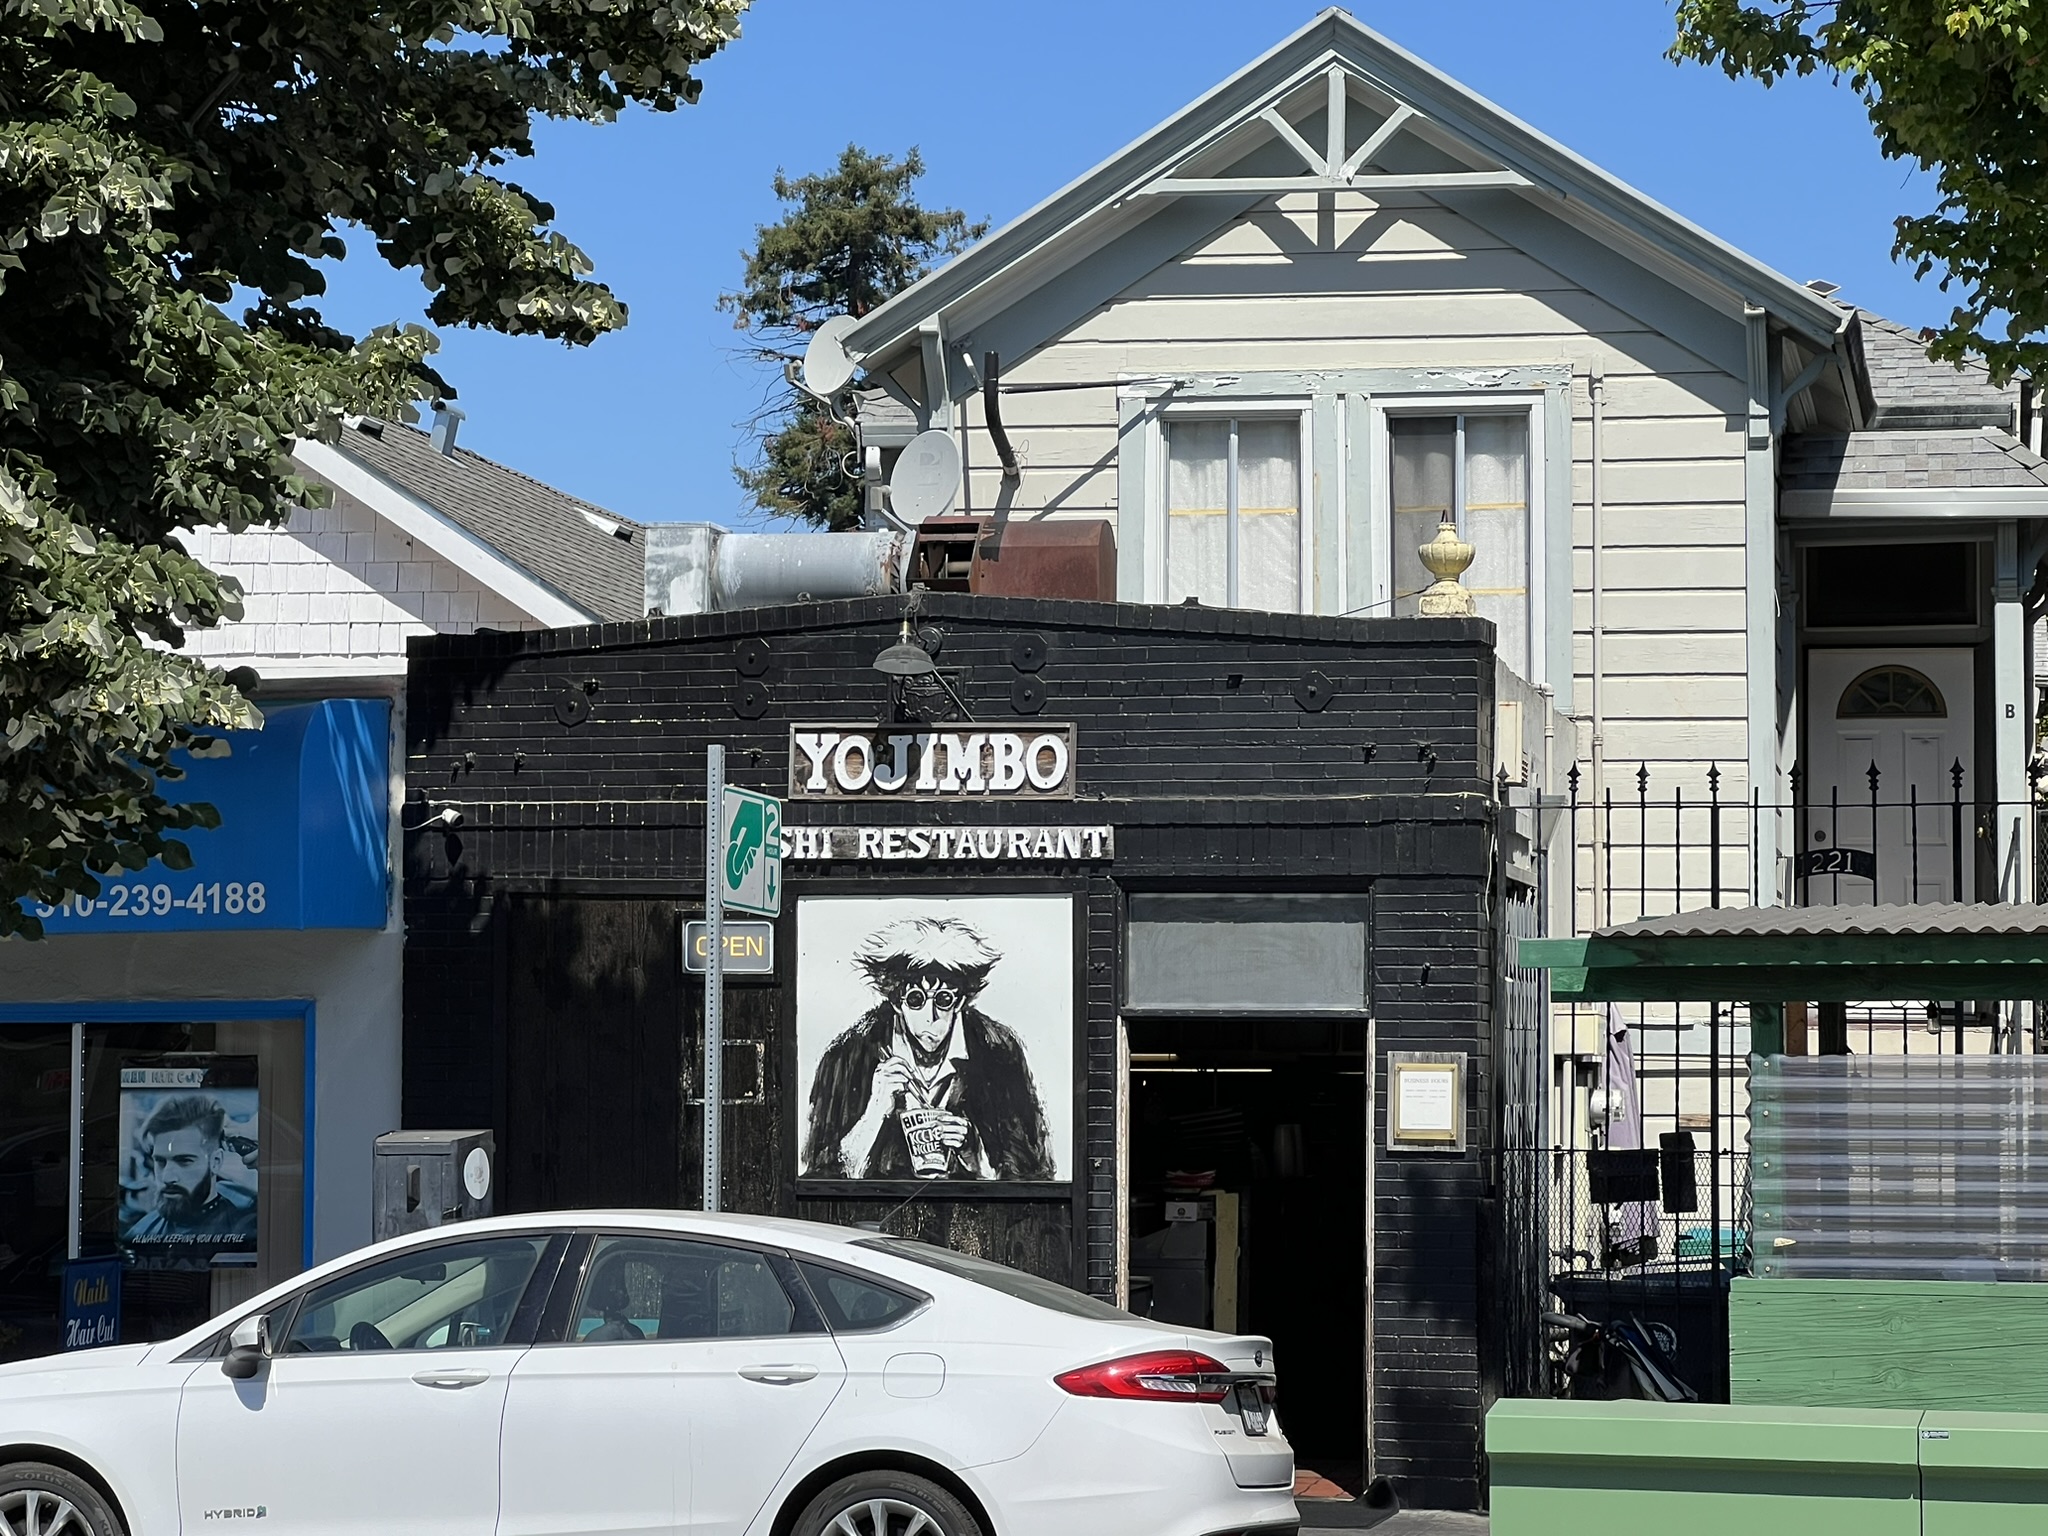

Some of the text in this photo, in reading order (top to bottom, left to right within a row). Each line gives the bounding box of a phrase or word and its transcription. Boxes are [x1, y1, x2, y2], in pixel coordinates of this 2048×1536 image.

[2004, 703, 2016, 719] B
[795, 733, 1068, 790] YOJIMBO
[766, 803, 779, 846] 2
[858, 827, 1107, 860] RESTAURANT
[903, 1113, 924, 1129] BIG
[132, 1233, 246, 1245] ALWAYS KEEPING YOU IN STYLE
[73, 1276, 108, 1307] Nails
[66, 1314, 115, 1348] Hair Cut
[203, 1508, 256, 1520] HYBRID
